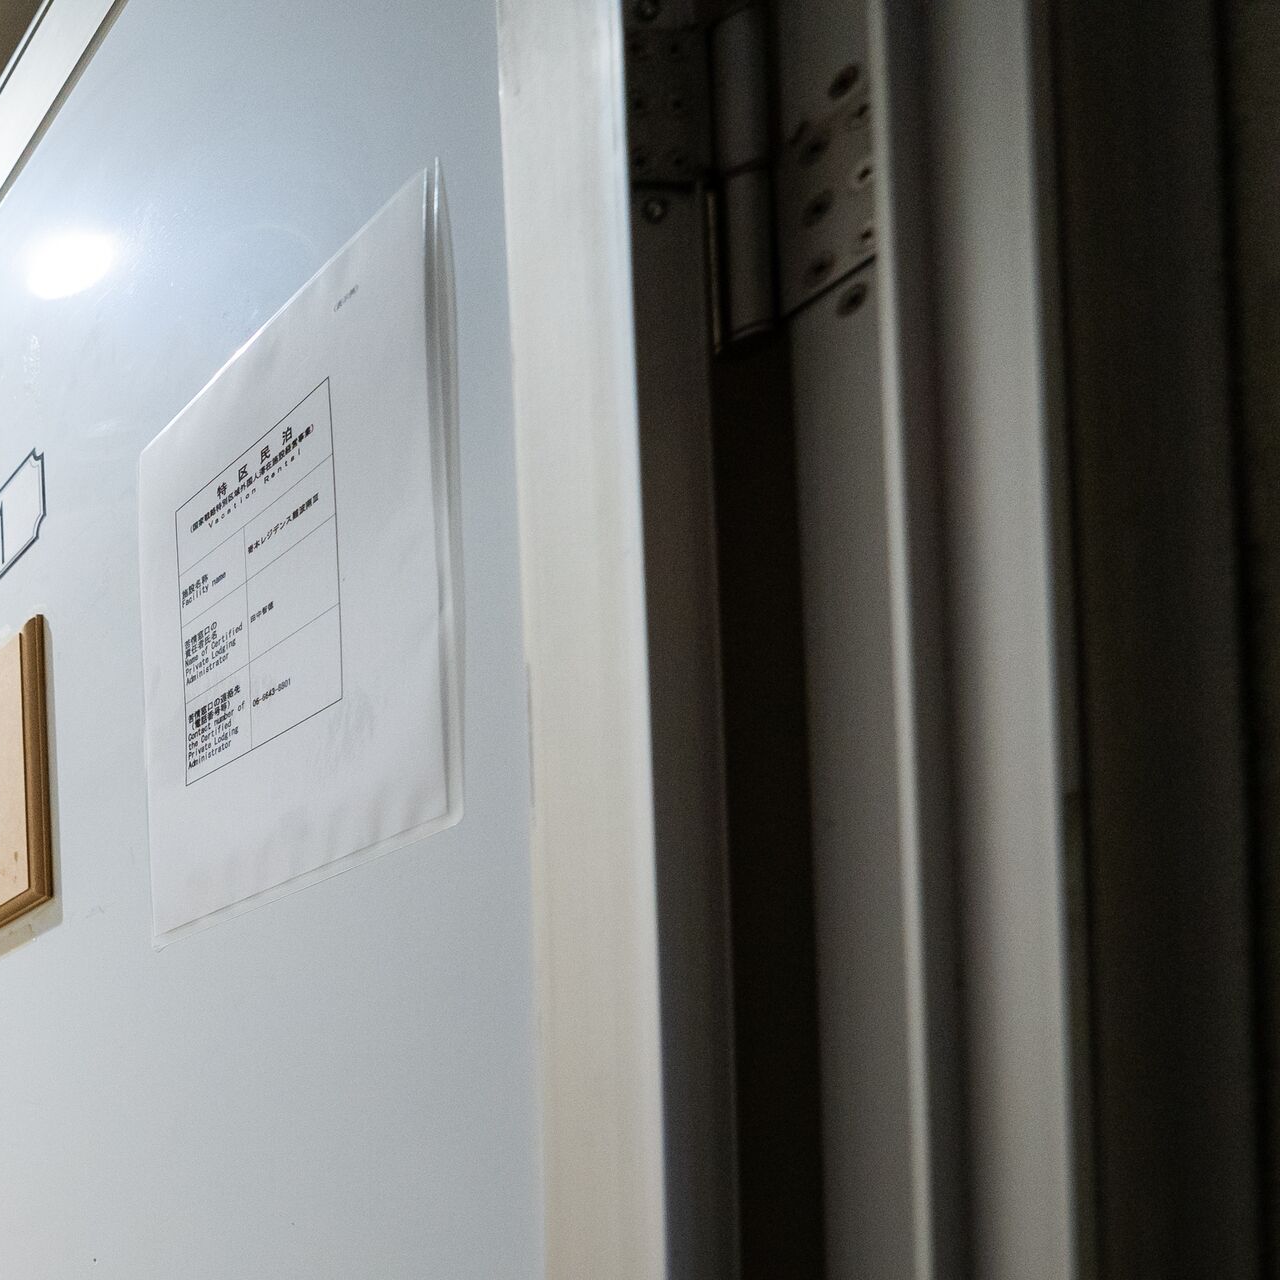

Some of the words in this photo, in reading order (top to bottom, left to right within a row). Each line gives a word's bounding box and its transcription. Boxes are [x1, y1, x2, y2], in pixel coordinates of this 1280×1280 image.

[216, 426, 292, 499] 特区民泊
[182, 584, 209, 608] Facility
[212, 572, 226, 587] name
[185, 655, 199, 667] Name
[201, 646, 208, 657] of
[211, 621, 243, 649] Certified
[185, 657, 209, 677] Private
[212, 638, 236, 660] Lodging
[186, 653, 229, 686] Administrator
[188, 723, 211, 742] Contact
[214, 709, 234, 725] number
[237, 700, 245, 711] of
[188, 740, 198, 751] the
[201, 719, 232, 743] Certified
[188, 743, 212, 760] Private
[214, 726, 239, 746] Lodging
[188, 740, 232, 770] Administrator
